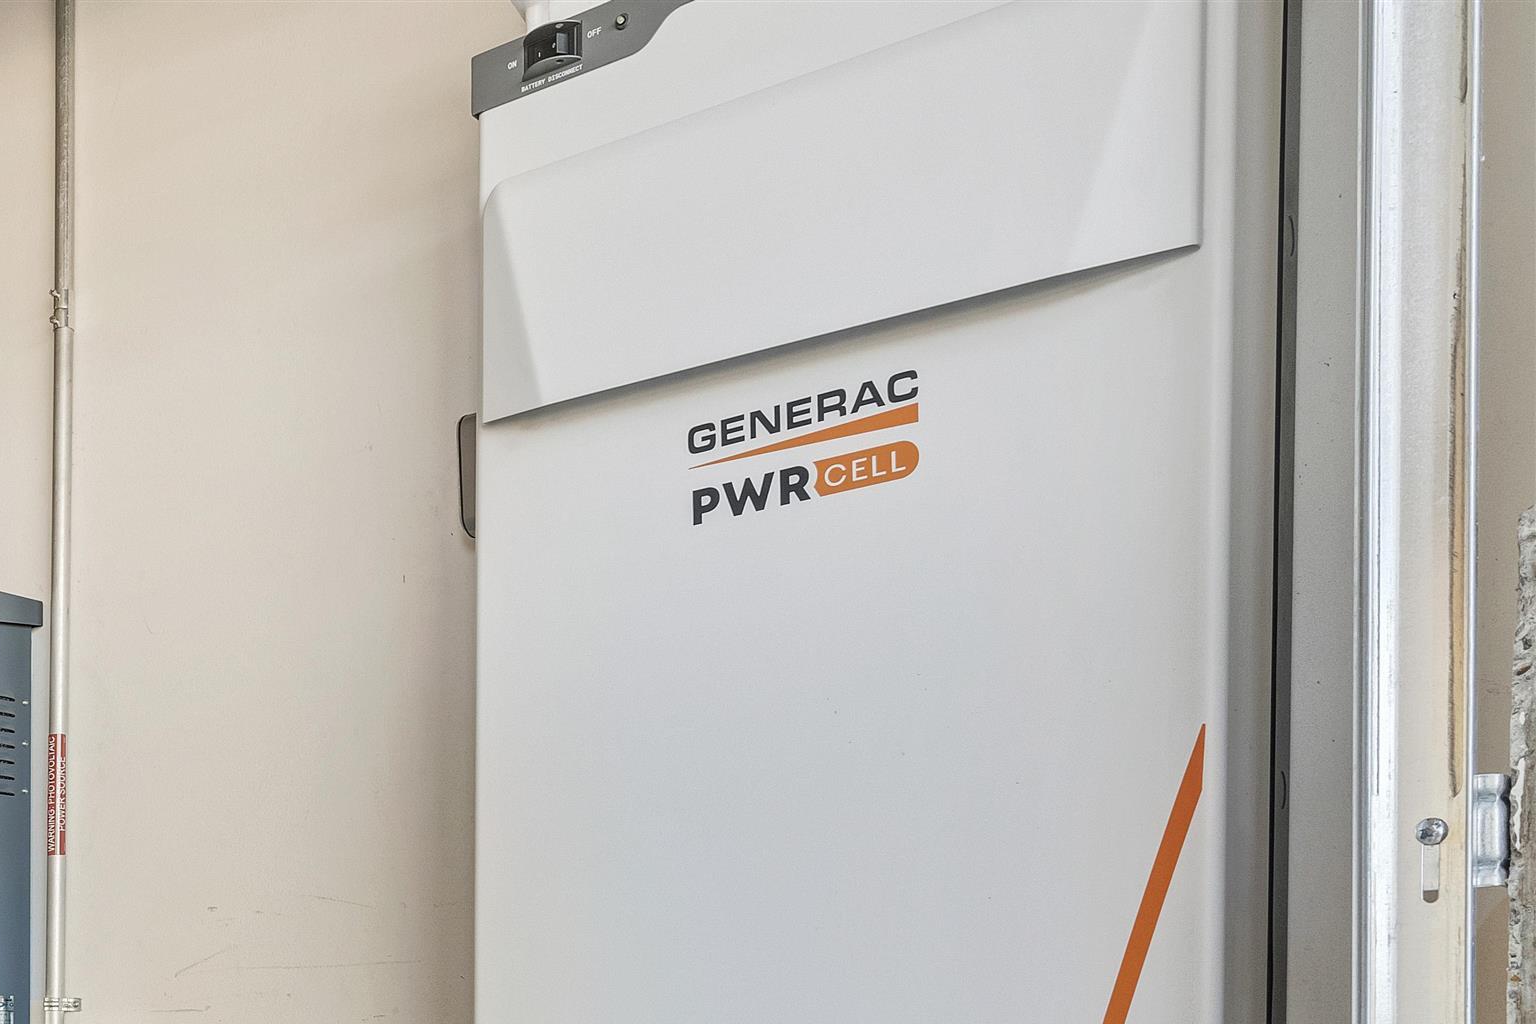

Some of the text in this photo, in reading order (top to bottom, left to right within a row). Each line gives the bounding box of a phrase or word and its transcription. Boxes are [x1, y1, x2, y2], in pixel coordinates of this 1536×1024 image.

[586, 26, 602, 39] OFF
[507, 60, 517, 70] ON
[520, 63, 584, 92] BATTERY DISCONNECT
[687, 369, 919, 455] GENERAC
[48, 736, 56, 852] WARNING: PHOTOVOLTAIC
